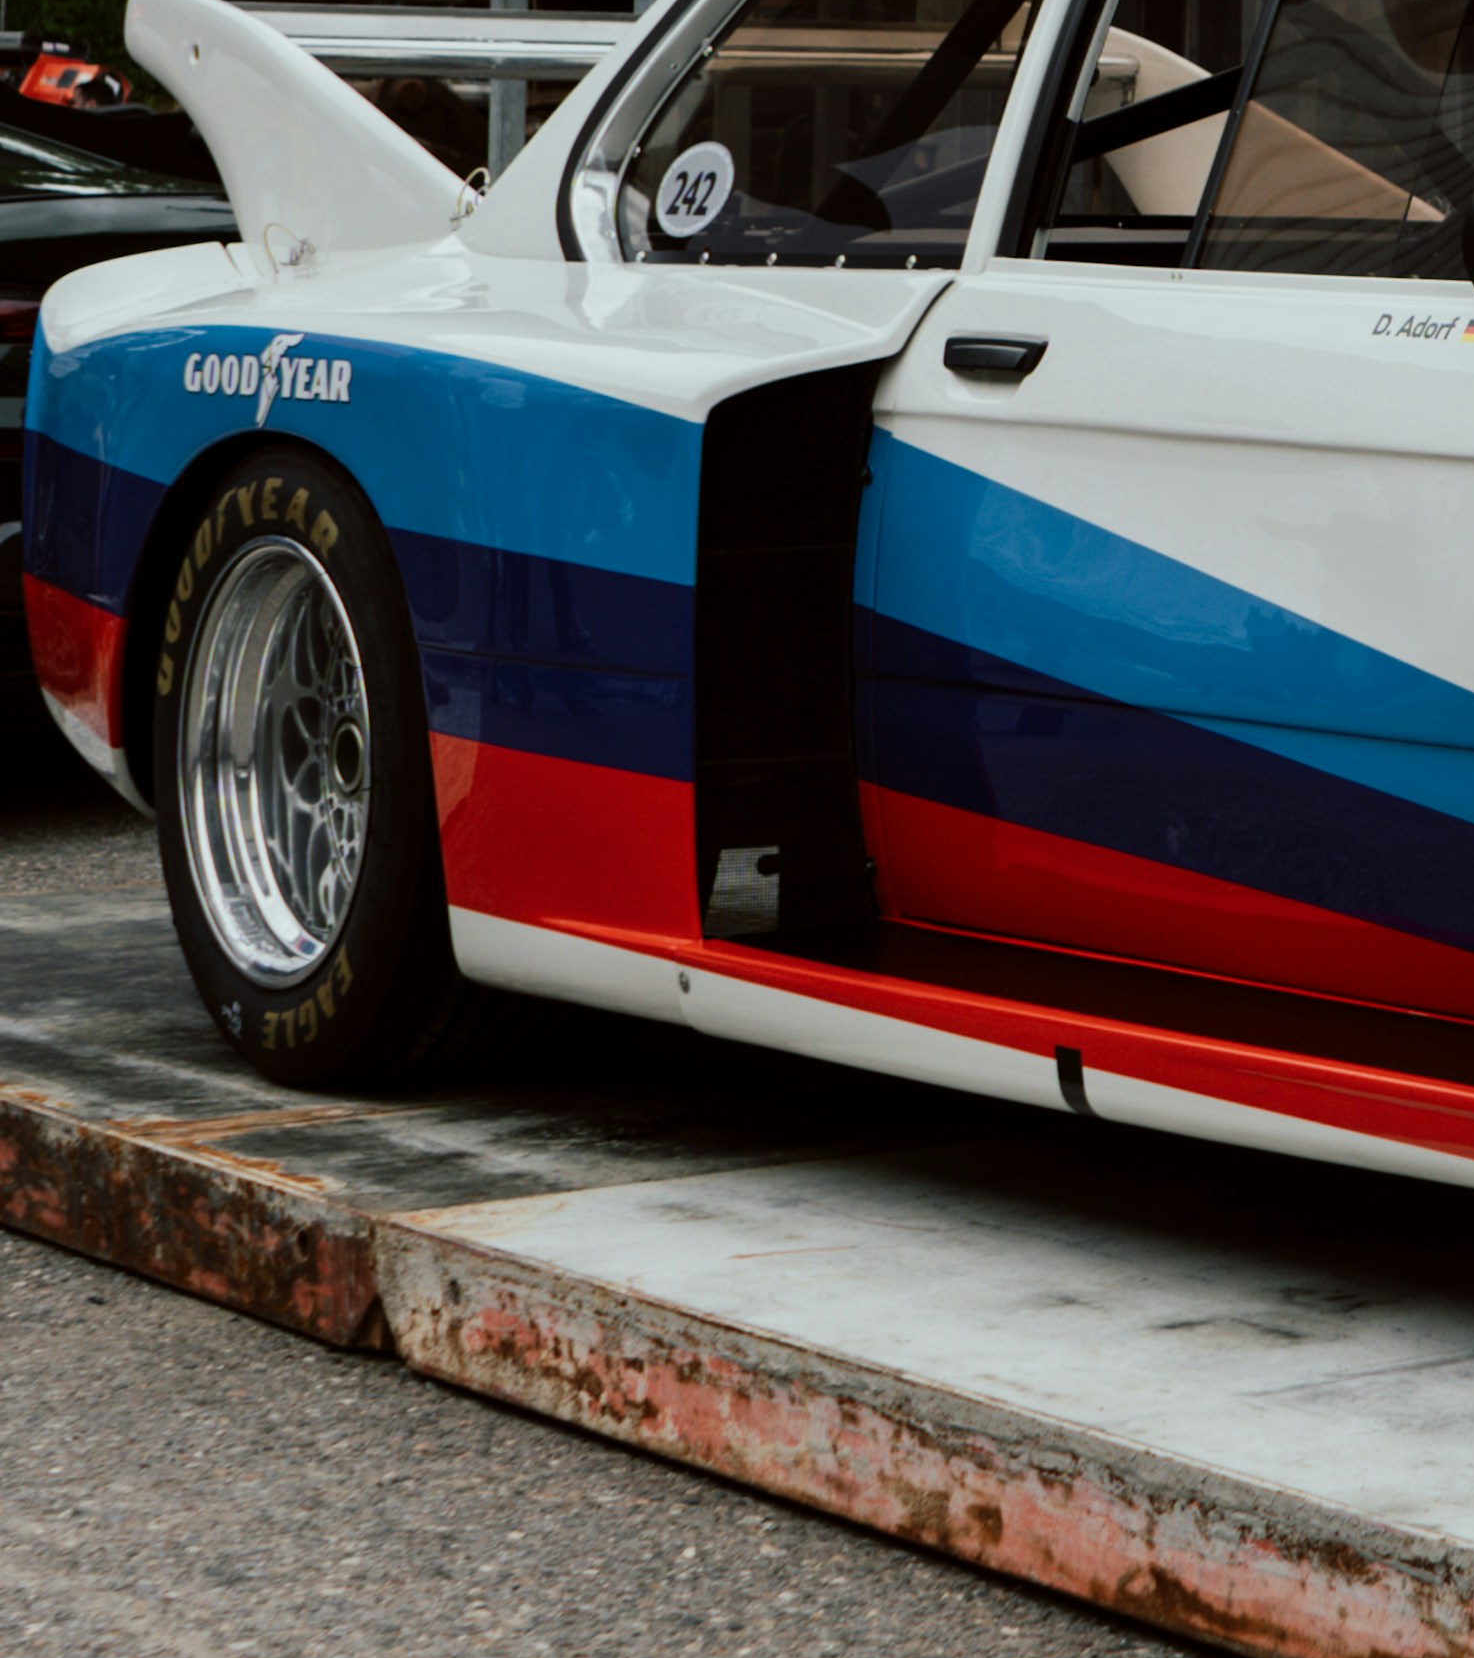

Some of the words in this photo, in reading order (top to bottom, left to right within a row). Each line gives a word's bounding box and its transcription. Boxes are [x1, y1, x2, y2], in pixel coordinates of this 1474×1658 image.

[665, 170, 718, 216] 242
[1371, 313, 1392, 336] D.
[1394, 314, 1462, 340] Adorf
[261, 941, 354, 1050] EAGLE
